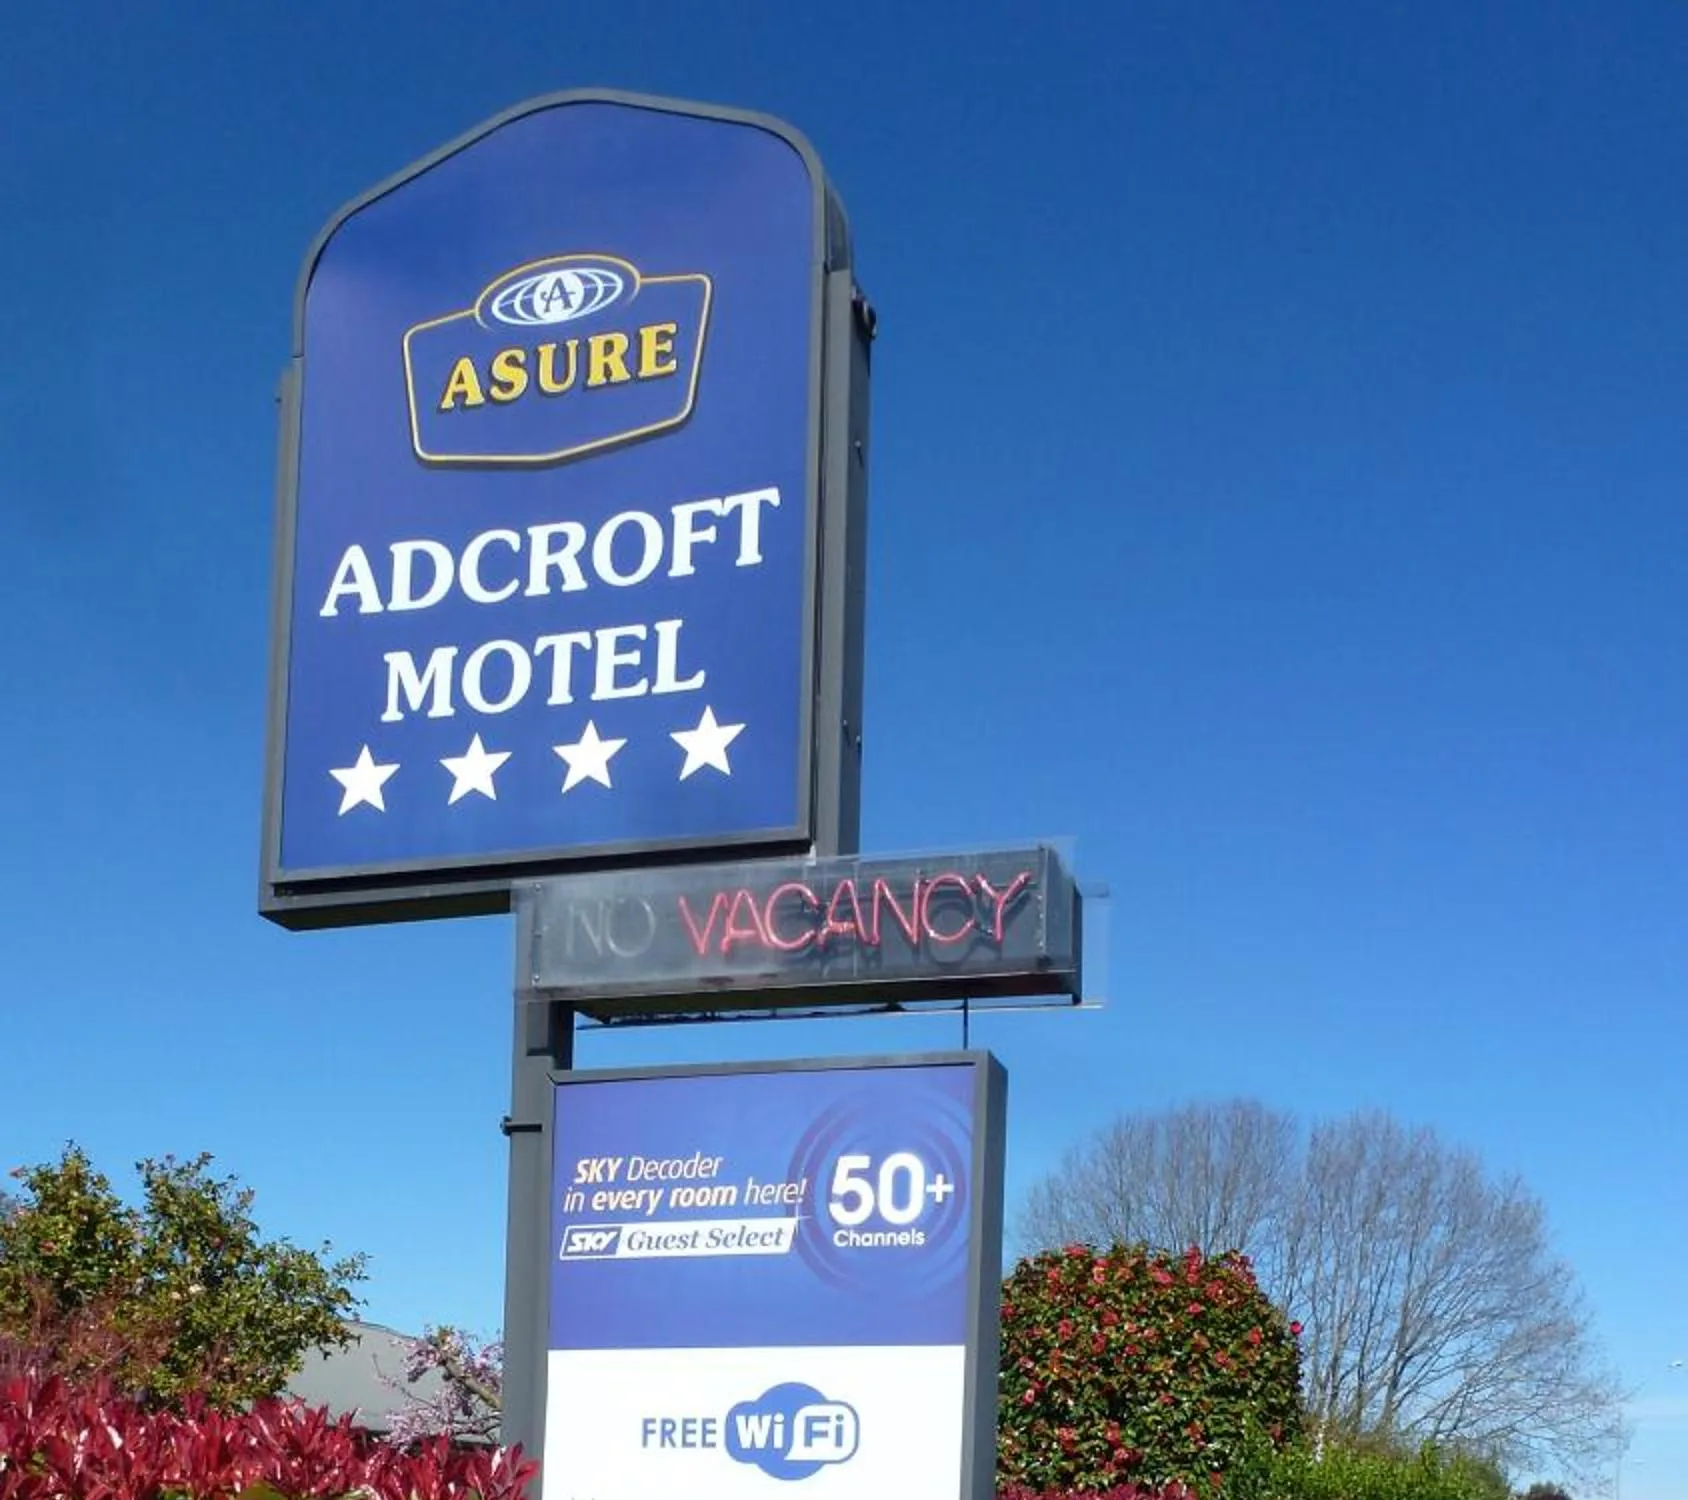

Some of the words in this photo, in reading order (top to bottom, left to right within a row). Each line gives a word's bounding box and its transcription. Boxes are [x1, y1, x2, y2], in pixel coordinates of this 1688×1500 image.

[439, 322, 679, 411] ASURE
[319, 487, 780, 617] ADCROFT
[380, 619, 705, 722] MOTEL
[566, 898, 657, 959] NO
[678, 871, 1032, 955] VACANCY
[574, 1157, 623, 1184] SKY
[627, 1152, 723, 1181] Decoder
[564, 1187, 585, 1213] in
[592, 1187, 663, 1216] every
[669, 1184, 738, 1208] room
[743, 1177, 807, 1205] here!
[567, 1231, 618, 1252] SKY
[627, 1229, 699, 1251] Guest
[705, 1225, 784, 1249] Select
[833, 1227, 926, 1248] Channels
[641, 1417, 717, 1449] FREE
